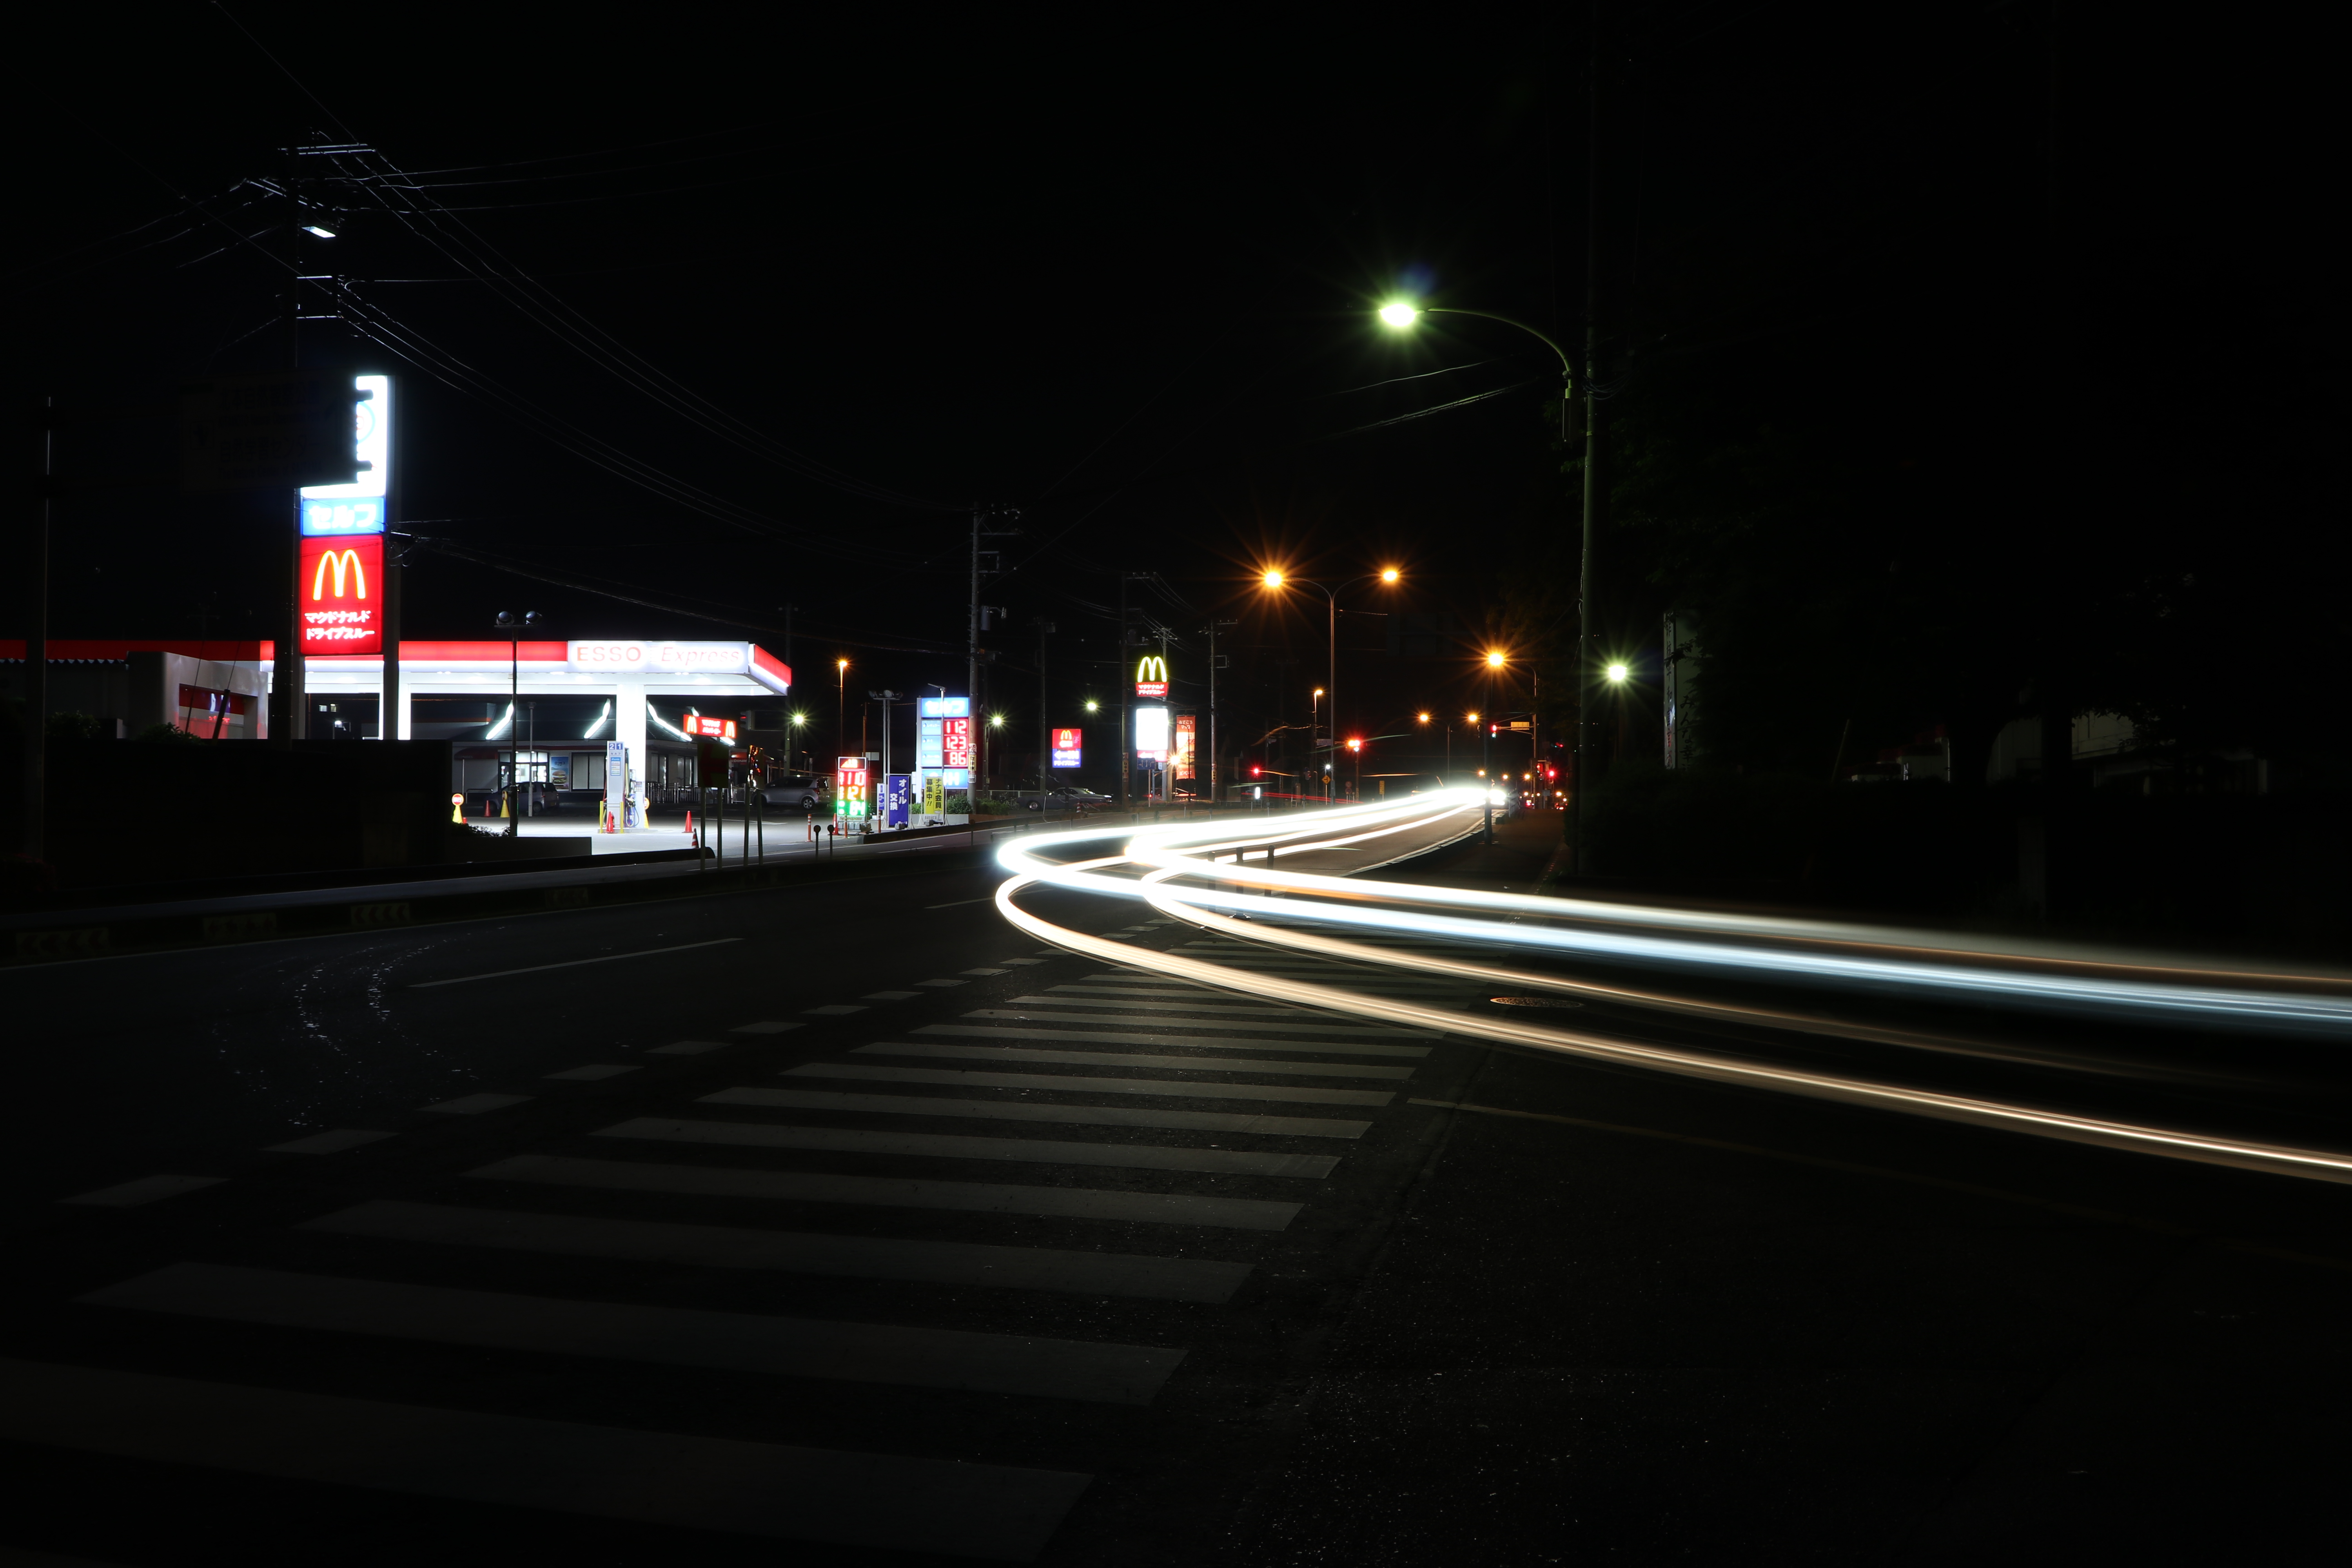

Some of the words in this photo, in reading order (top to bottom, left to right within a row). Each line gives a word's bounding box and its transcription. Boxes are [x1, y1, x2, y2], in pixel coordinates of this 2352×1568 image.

[309, 504, 377, 529] セルフ
[305, 610, 371, 624] マクドナルド
[306, 626, 375, 640] ドライブスルー
[577, 646, 642, 661] ESSO
[661, 646, 740, 666] Express
[946, 720, 966, 734] 112
[947, 736, 966, 749] 123
[950, 751, 966, 765] 86
[848, 771, 865, 786] 110
[847, 786, 865, 800] 121
[898, 779, 907, 804] オイル
[849, 801, 865, 815] 84
[890, 793, 898, 810] 交換
